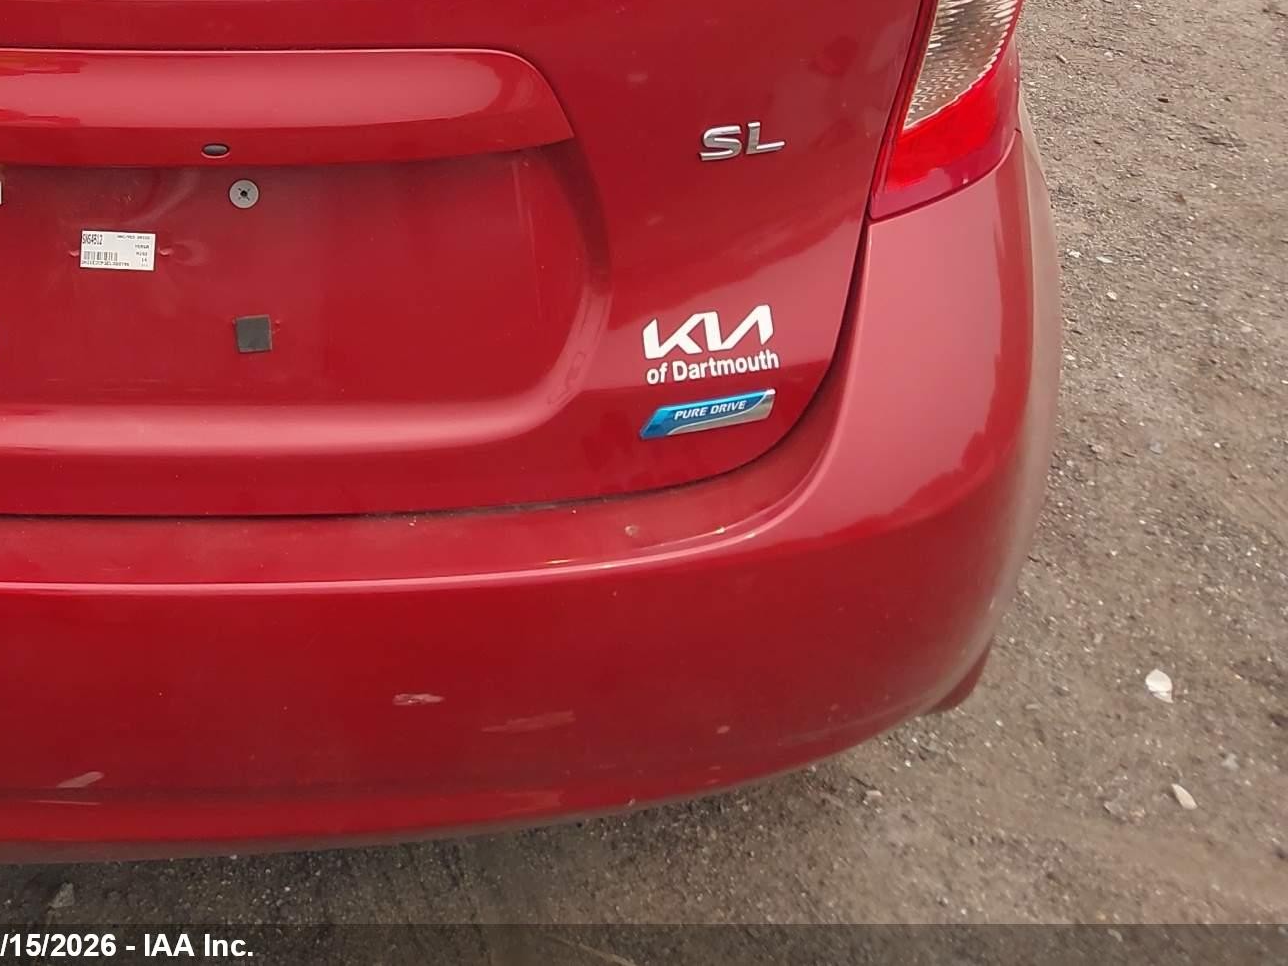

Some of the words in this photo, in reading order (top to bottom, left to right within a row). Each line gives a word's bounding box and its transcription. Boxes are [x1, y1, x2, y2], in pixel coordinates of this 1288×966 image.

[699, 121, 785, 161] SL
[642, 304, 774, 360] KIA
[646, 360, 667, 385] of
[672, 349, 779, 381] Dartmouth
[674, 405, 708, 421] PURE
[710, 399, 747, 415] DRIVE
